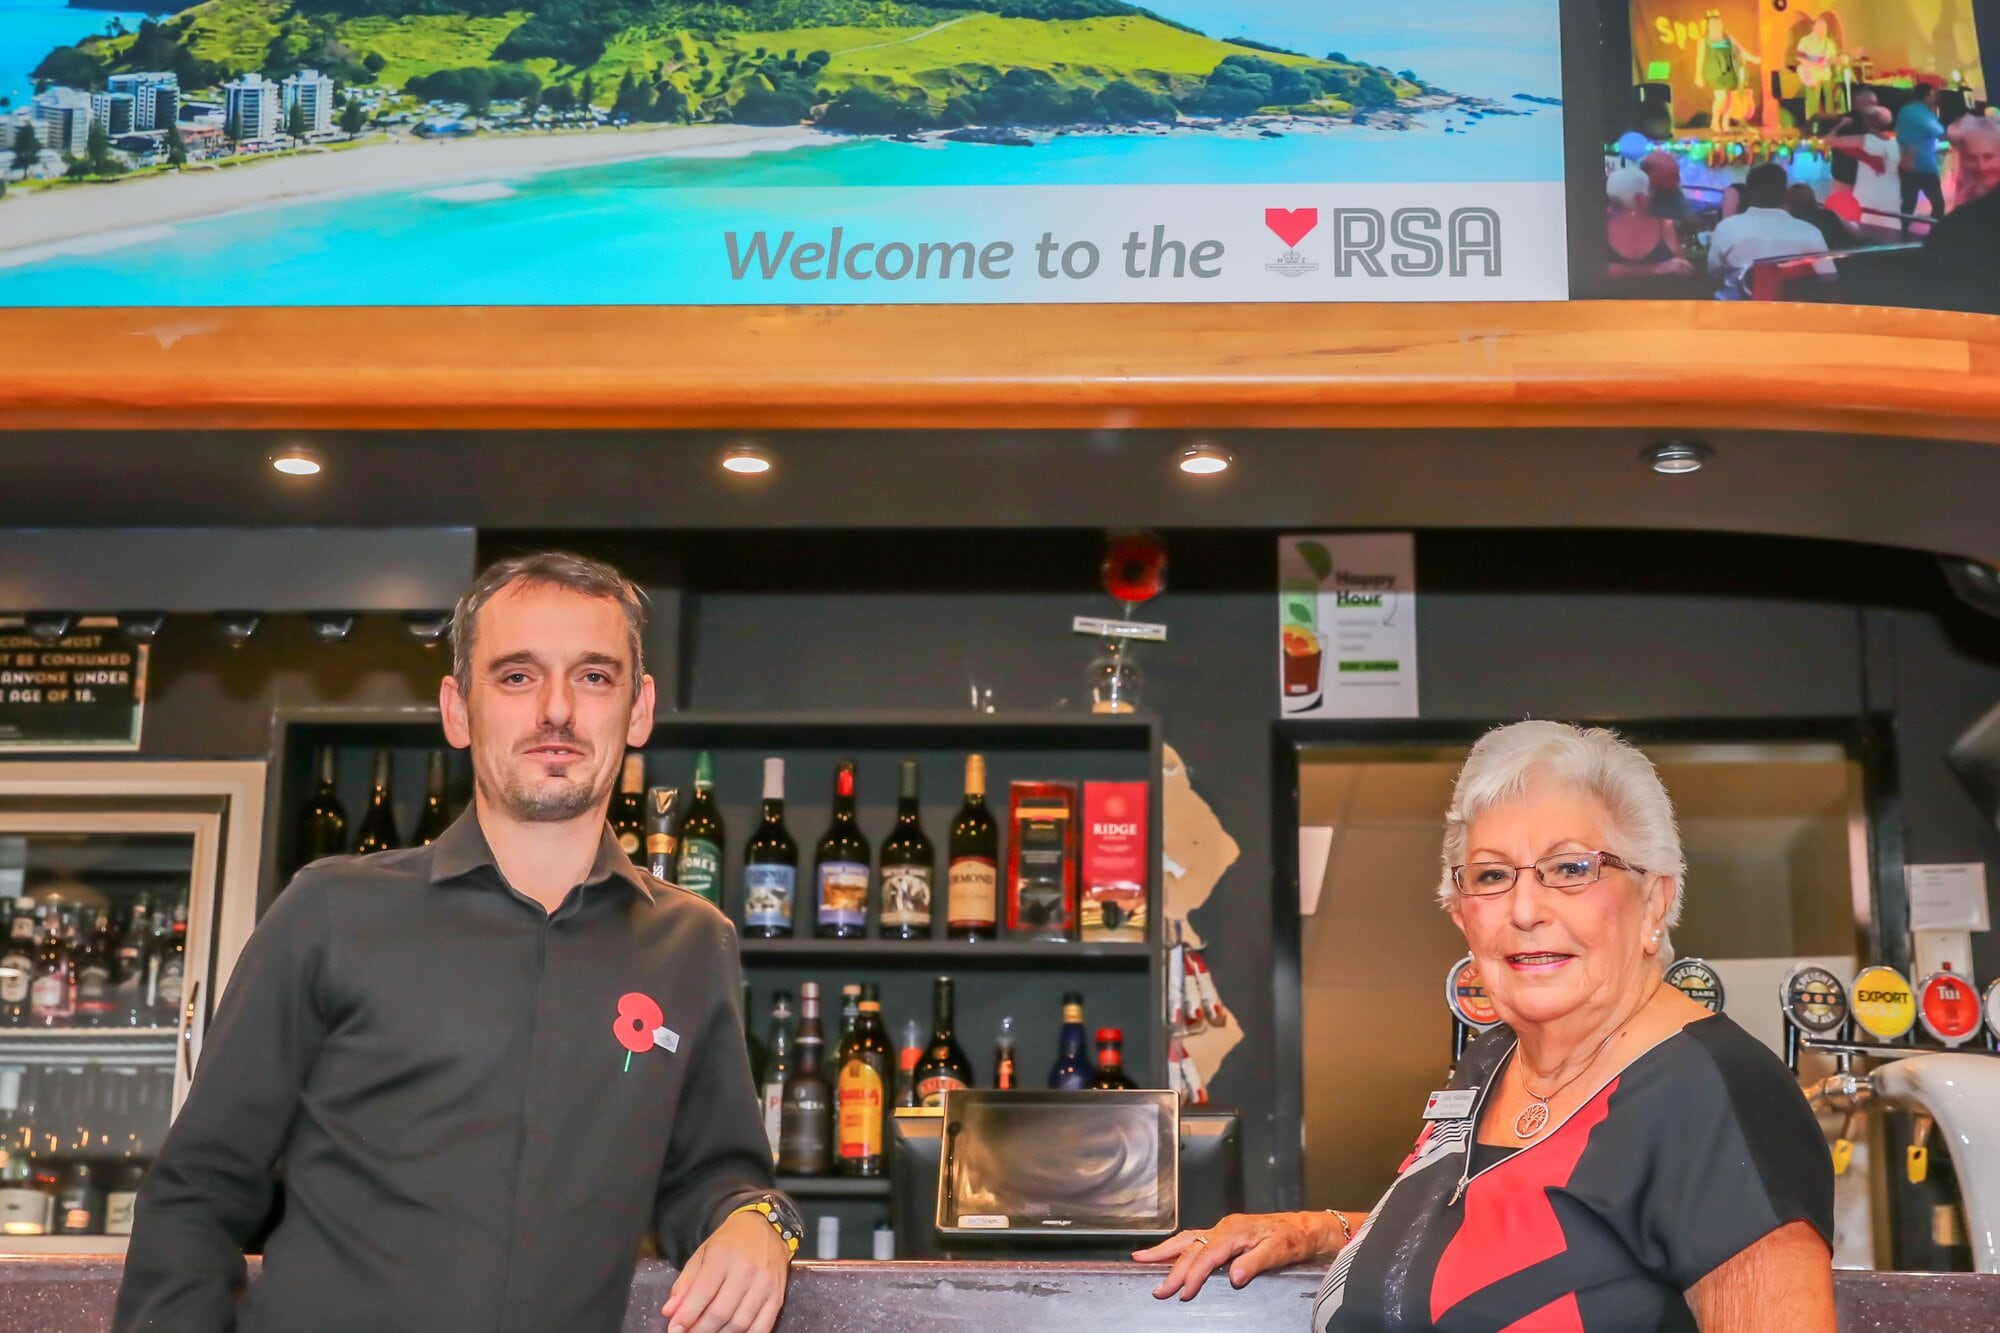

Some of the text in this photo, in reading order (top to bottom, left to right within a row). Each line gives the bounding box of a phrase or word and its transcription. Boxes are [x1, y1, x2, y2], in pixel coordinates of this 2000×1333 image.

[1333, 207, 1501, 277] RSA
[724, 224, 1224, 280] Welcome to the
[1336, 571, 1396, 589] Happy
[1337, 590, 1383, 606] Hour
[16, 654, 34, 666] BE
[41, 654, 131, 666] CONSUMED
[1, 672, 129, 684] ANYONE UNDER
[9, 690, 41, 702] AGE
[47, 690, 69, 702] OF
[75, 689, 96, 702] 18.
[1093, 823, 1138, 836] RIDGE
[1671, 966, 1716, 988] SPEIGHT'S
[1858, 990, 1908, 1004] EXPORT
